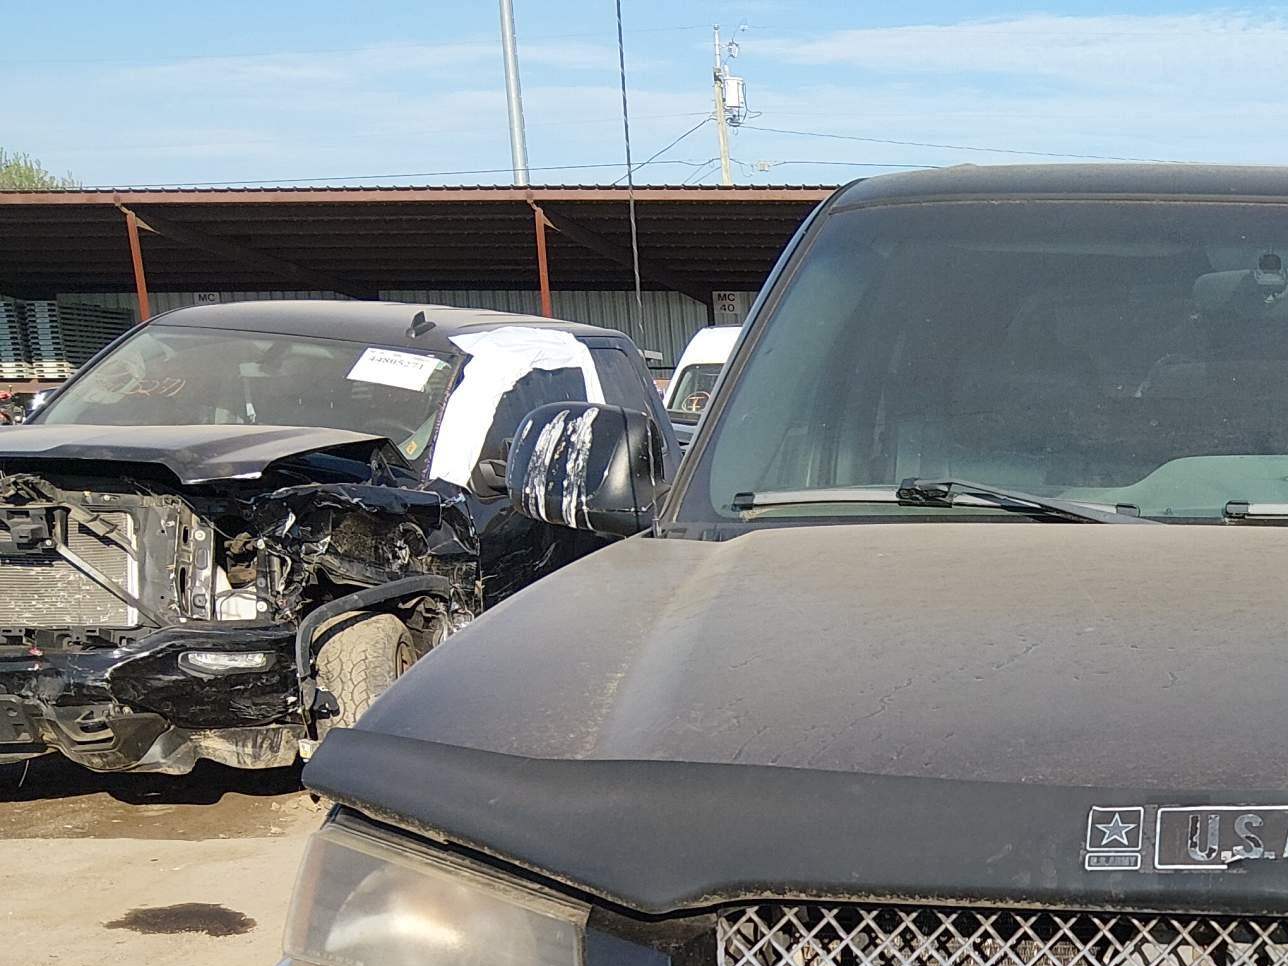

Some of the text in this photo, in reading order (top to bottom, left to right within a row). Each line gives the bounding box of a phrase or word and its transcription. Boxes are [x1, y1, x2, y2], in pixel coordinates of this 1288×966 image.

[198, 293, 217, 302] MC
[717, 293, 736, 302] MC
[720, 304, 735, 313] 40
